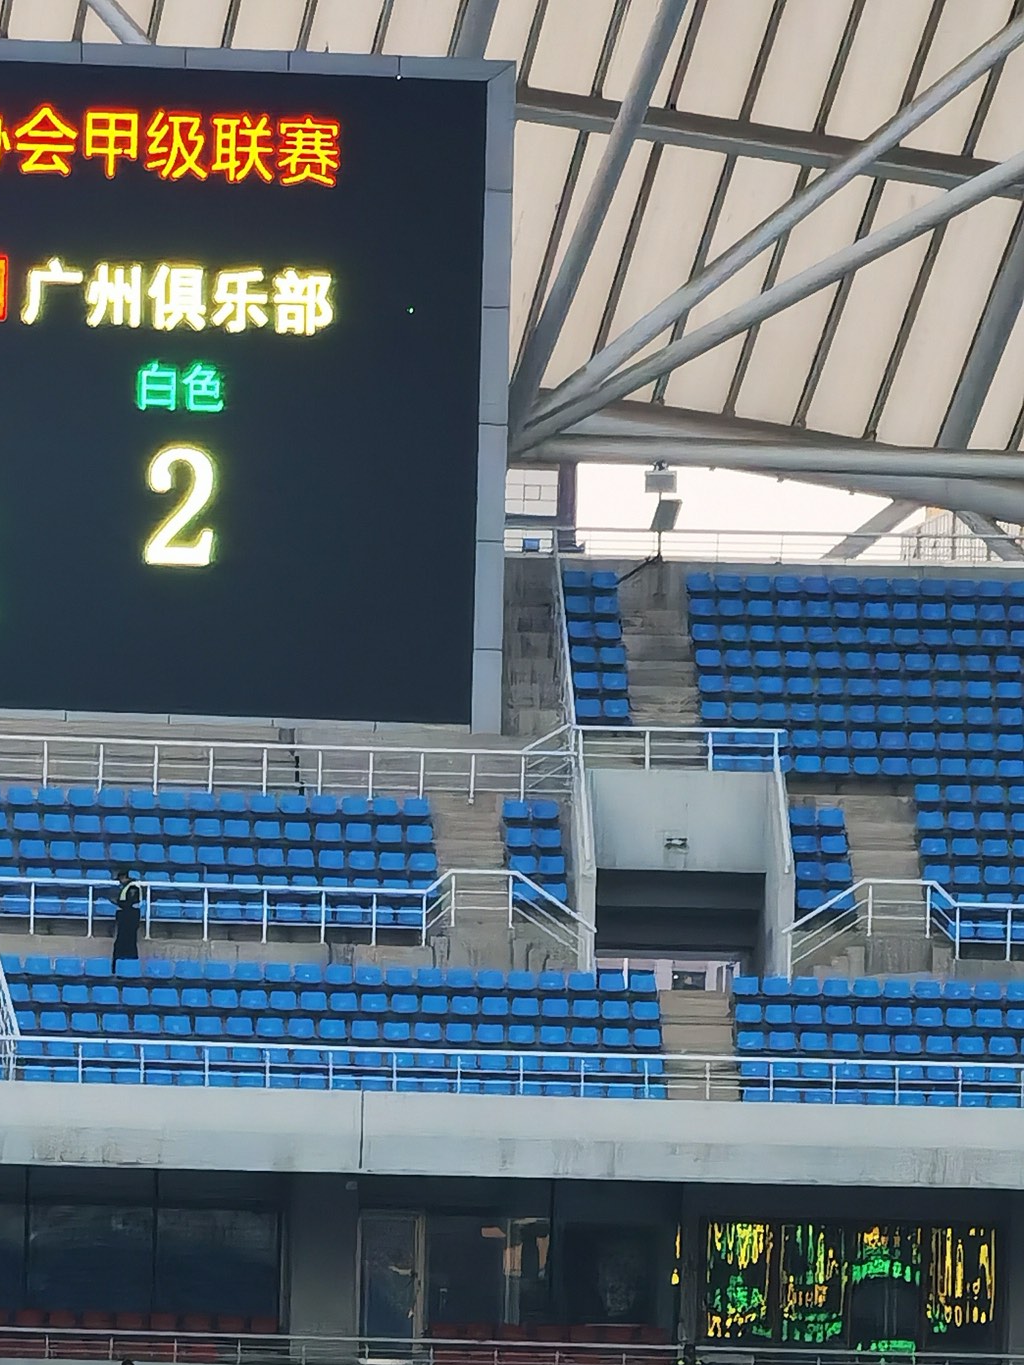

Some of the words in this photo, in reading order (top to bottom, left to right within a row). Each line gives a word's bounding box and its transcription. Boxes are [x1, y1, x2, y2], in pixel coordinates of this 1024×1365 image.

[21, 257, 334, 336] 广州俱乐部
[135, 361, 224, 412] 白色
[143, 443, 217, 567] 2
